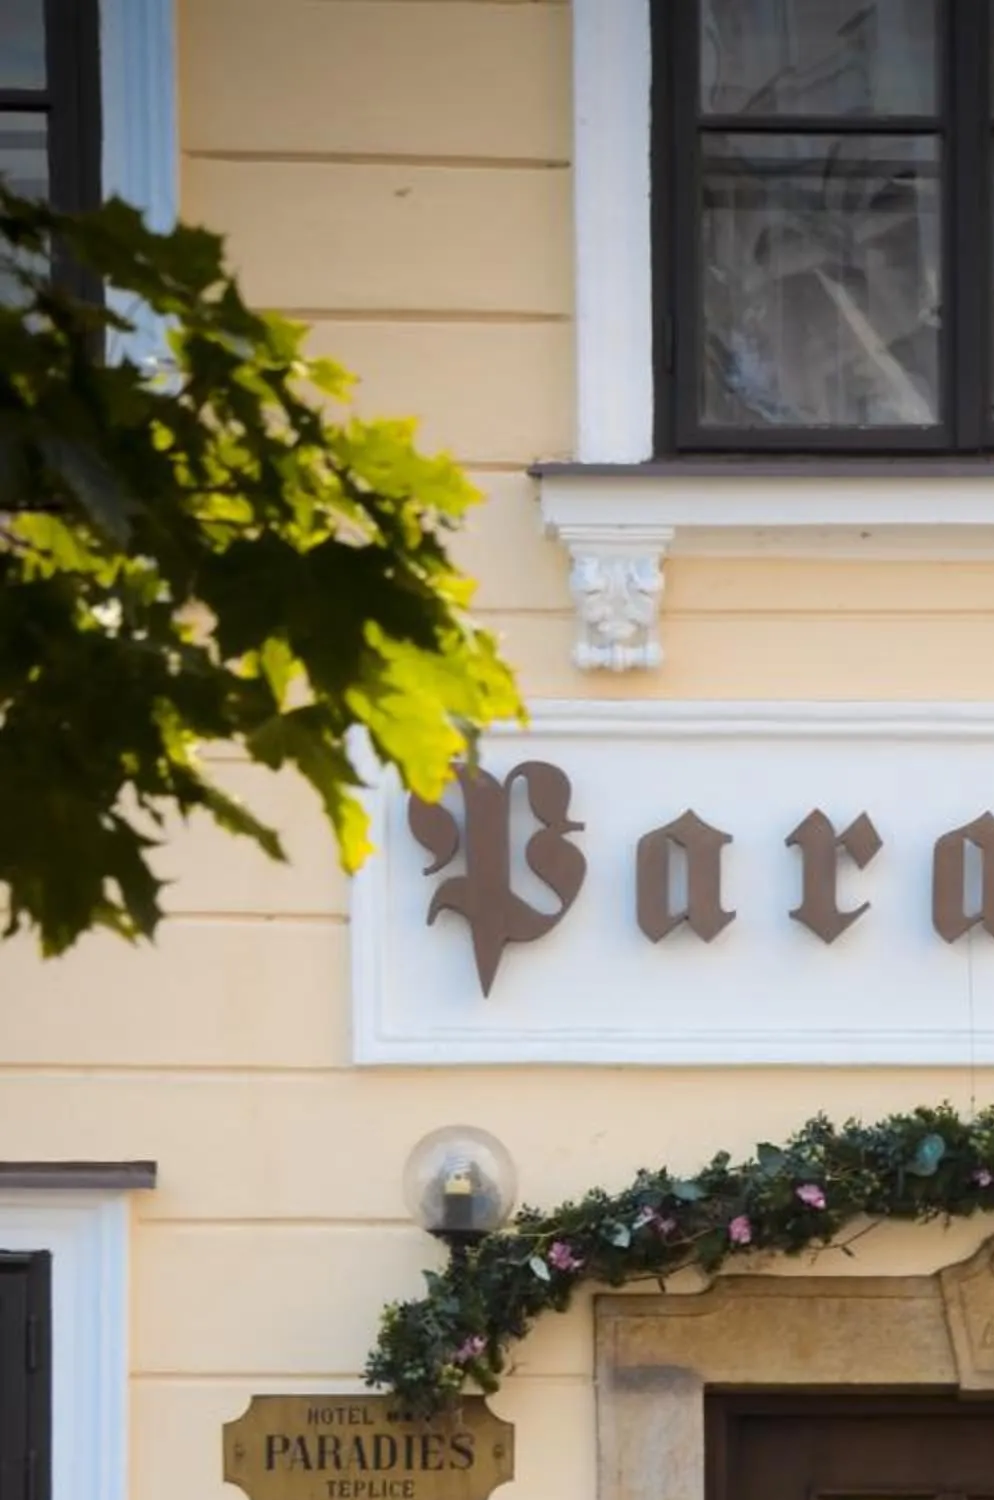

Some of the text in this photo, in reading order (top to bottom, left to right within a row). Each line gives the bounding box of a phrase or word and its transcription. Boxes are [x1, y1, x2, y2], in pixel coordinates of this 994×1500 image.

[307, 1407, 375, 1426] HOTEL
[265, 1433, 475, 1472] PARADIES
[326, 1479, 415, 1499] TEPLICE
